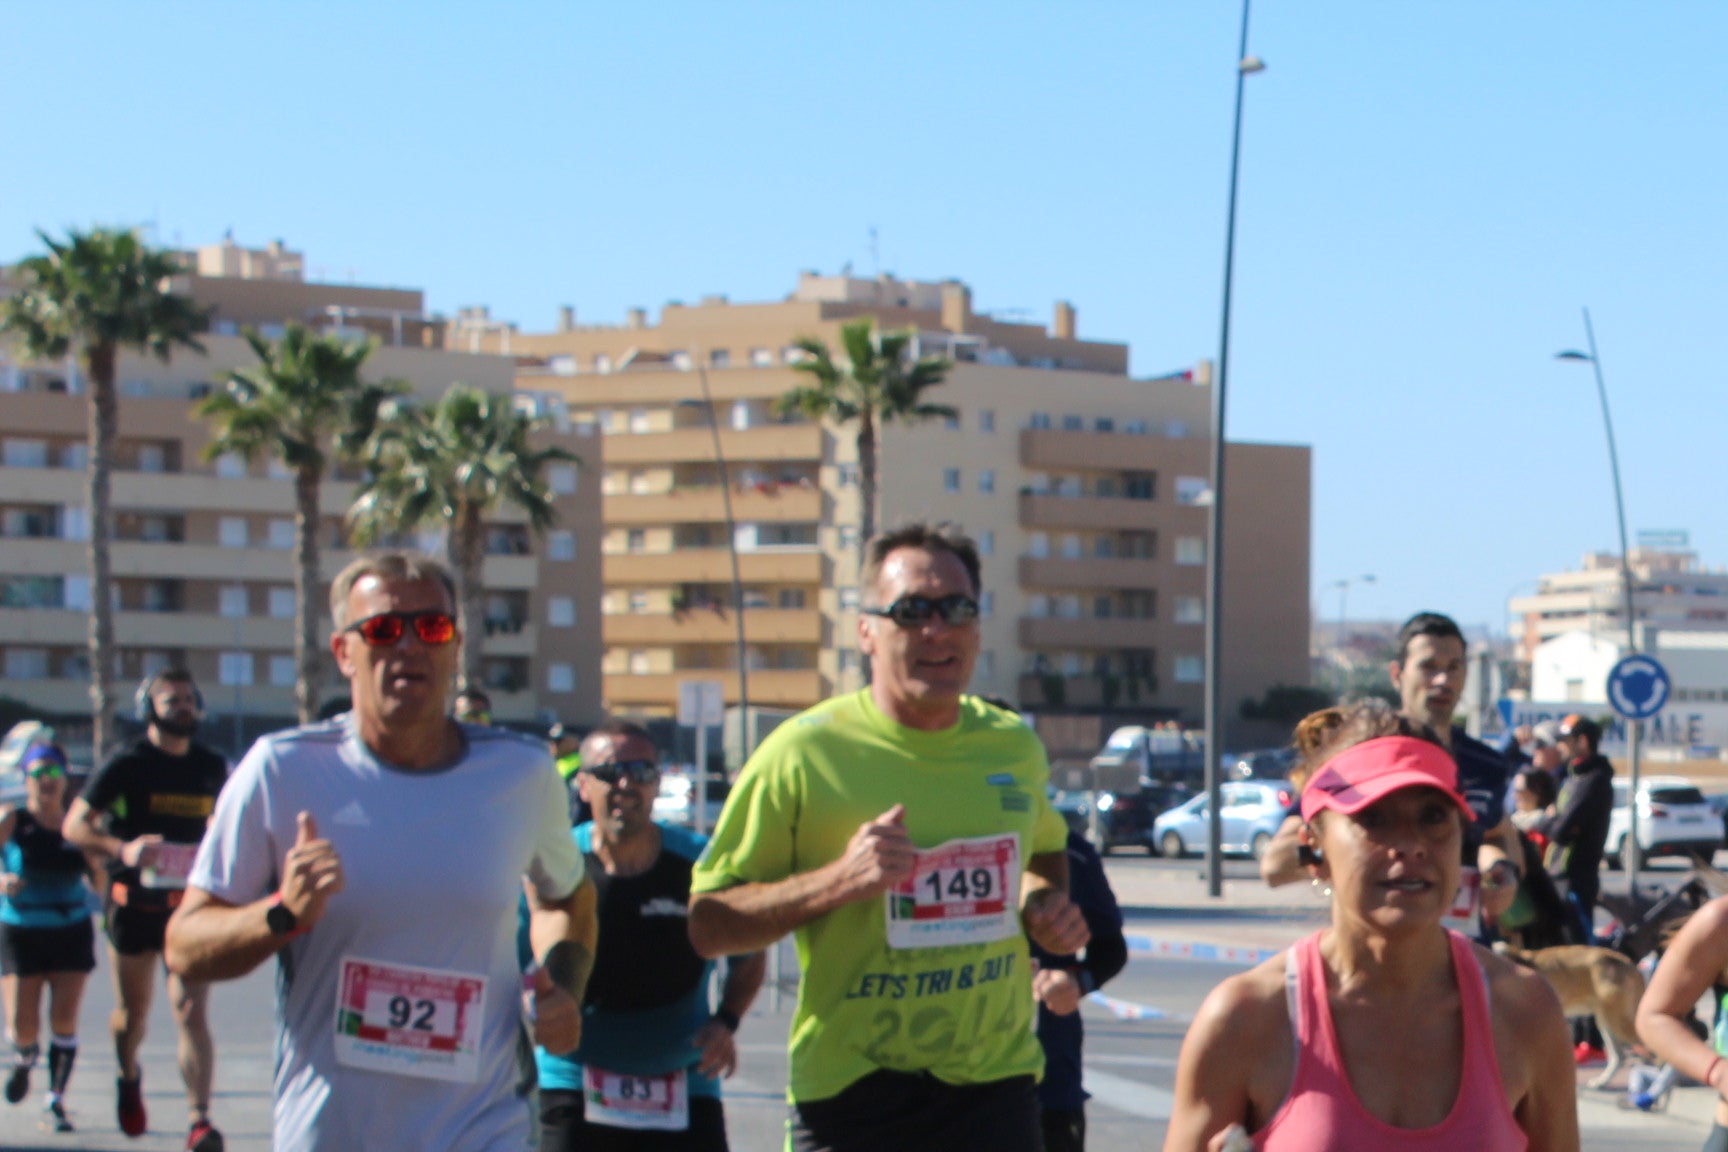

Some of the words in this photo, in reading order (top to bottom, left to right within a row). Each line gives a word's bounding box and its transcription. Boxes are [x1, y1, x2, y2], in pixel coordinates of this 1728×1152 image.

[926, 867, 993, 901] 149
[915, 969, 954, 997] TRI
[957, 963, 975, 990] &
[388, 994, 437, 1032] 92
